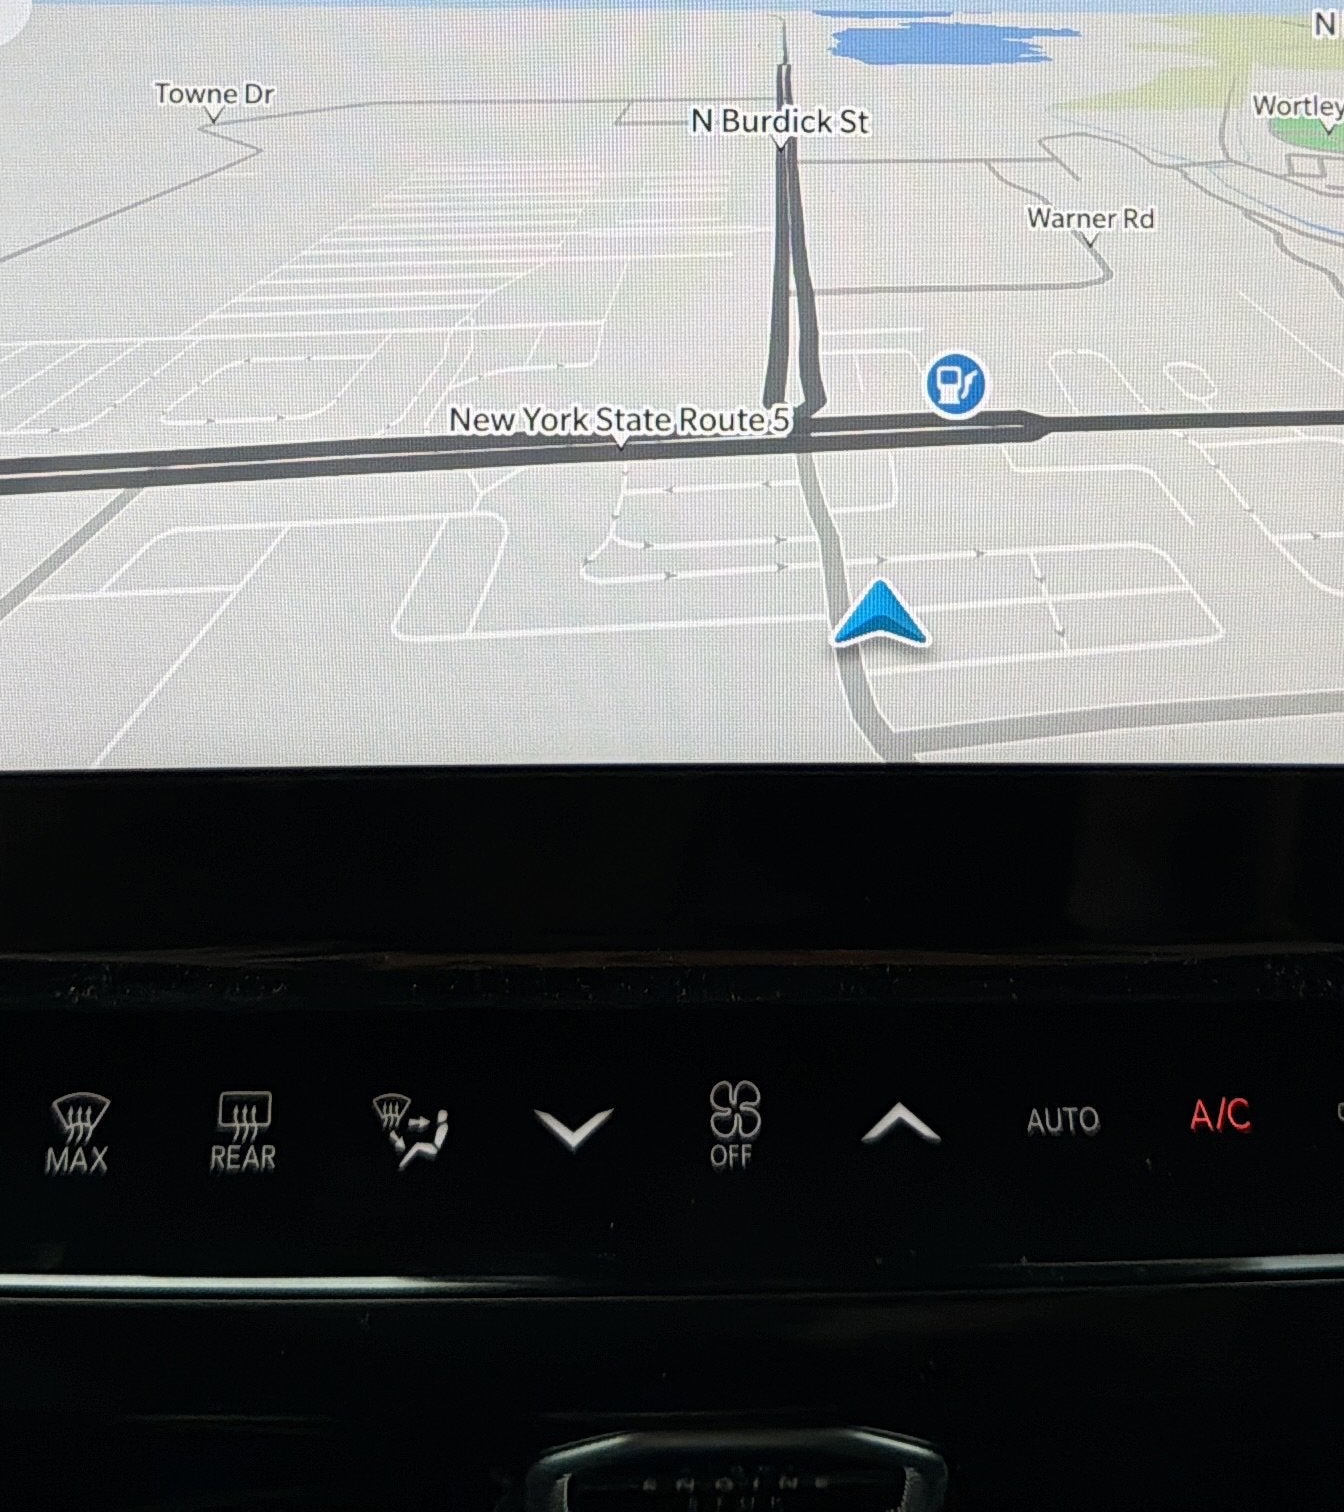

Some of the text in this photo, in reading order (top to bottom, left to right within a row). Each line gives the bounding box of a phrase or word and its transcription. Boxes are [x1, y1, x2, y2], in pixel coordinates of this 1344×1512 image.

[1314, 13, 1337, 38] N
[154, 82, 275, 107] Towne Dr
[692, 107, 870, 136] N Burdick St
[1026, 205, 1154, 229] Warner Rd
[450, 407, 790, 433] New York State Route 5
[1026, 1106, 1100, 1134] AUTO
[1189, 1096, 1251, 1131] A/C
[44, 1143, 109, 1173] MAX
[209, 1142, 276, 1171] REAR
[709, 1143, 752, 1168] OFF
